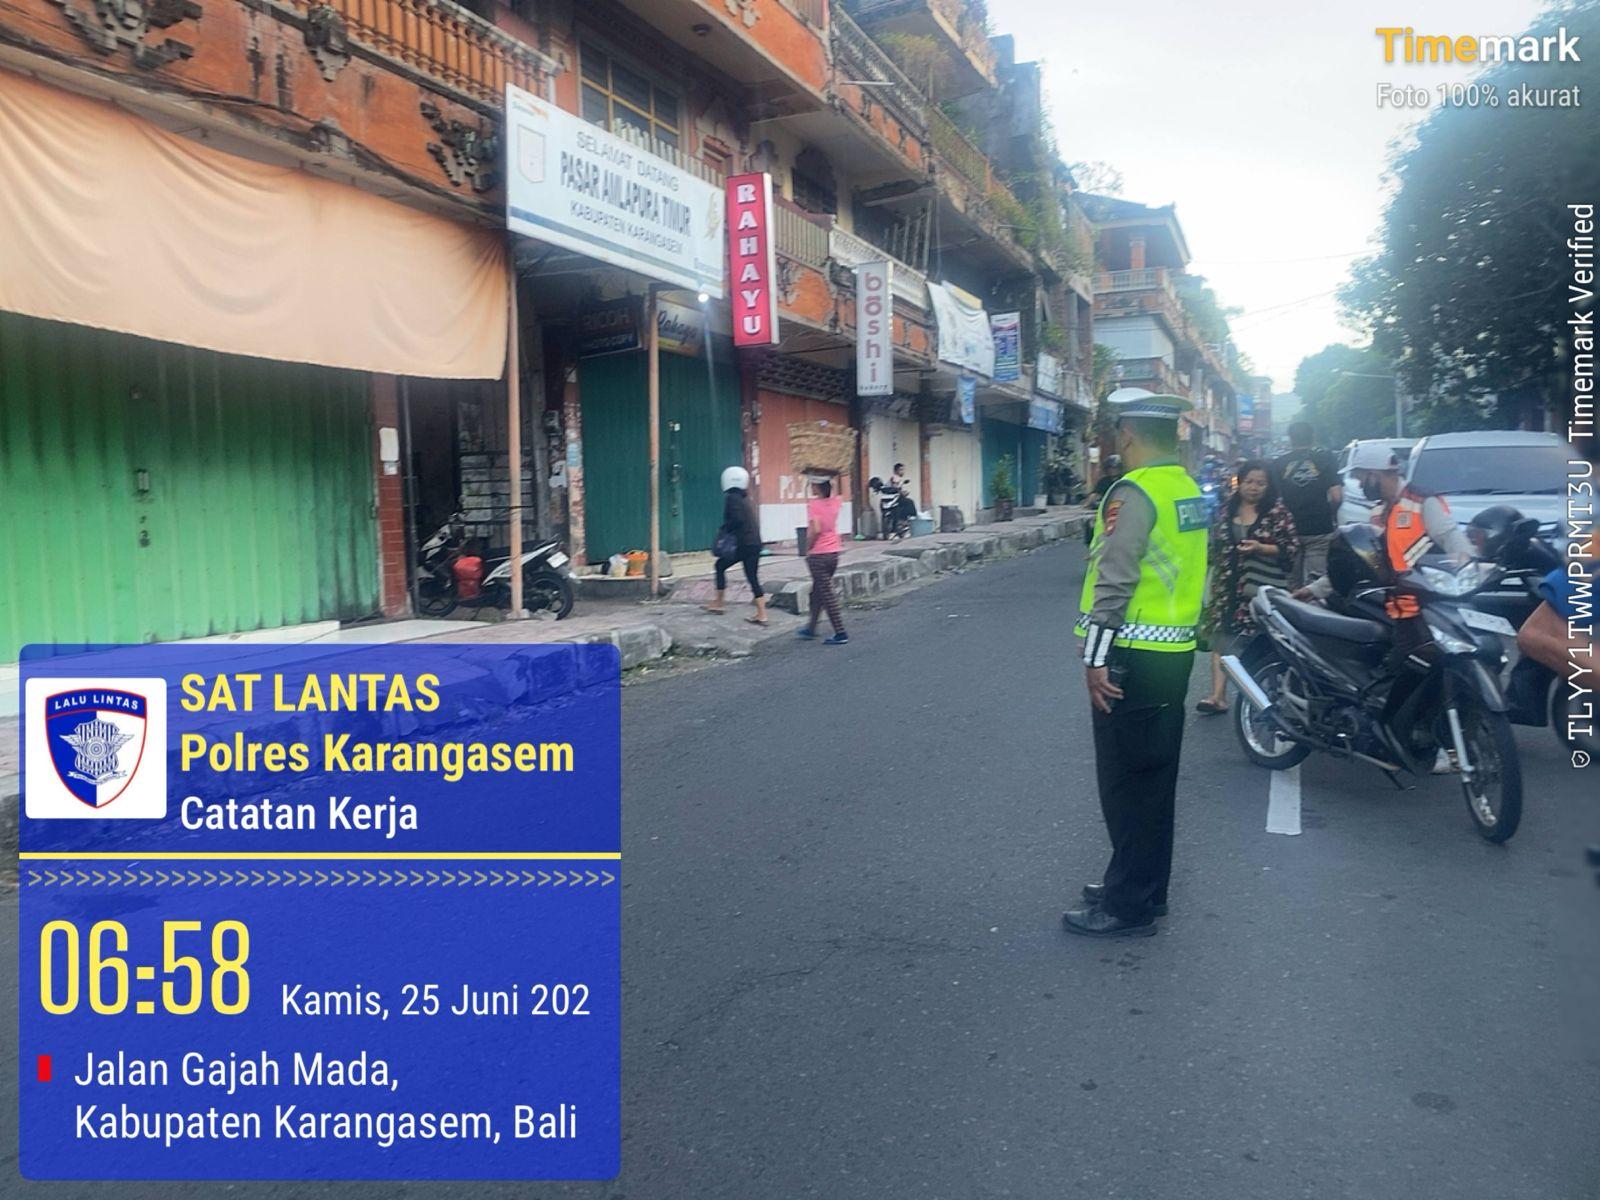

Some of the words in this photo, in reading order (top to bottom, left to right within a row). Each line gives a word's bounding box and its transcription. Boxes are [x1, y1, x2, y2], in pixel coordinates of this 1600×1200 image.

[560, 150, 600, 200] PASAR
[576, 130, 632, 170] SELAMAT
[637, 160, 680, 192] DATANG
[570, 200, 626, 235] KABUPATEN
[736, 183, 762, 336] RAHAYU
